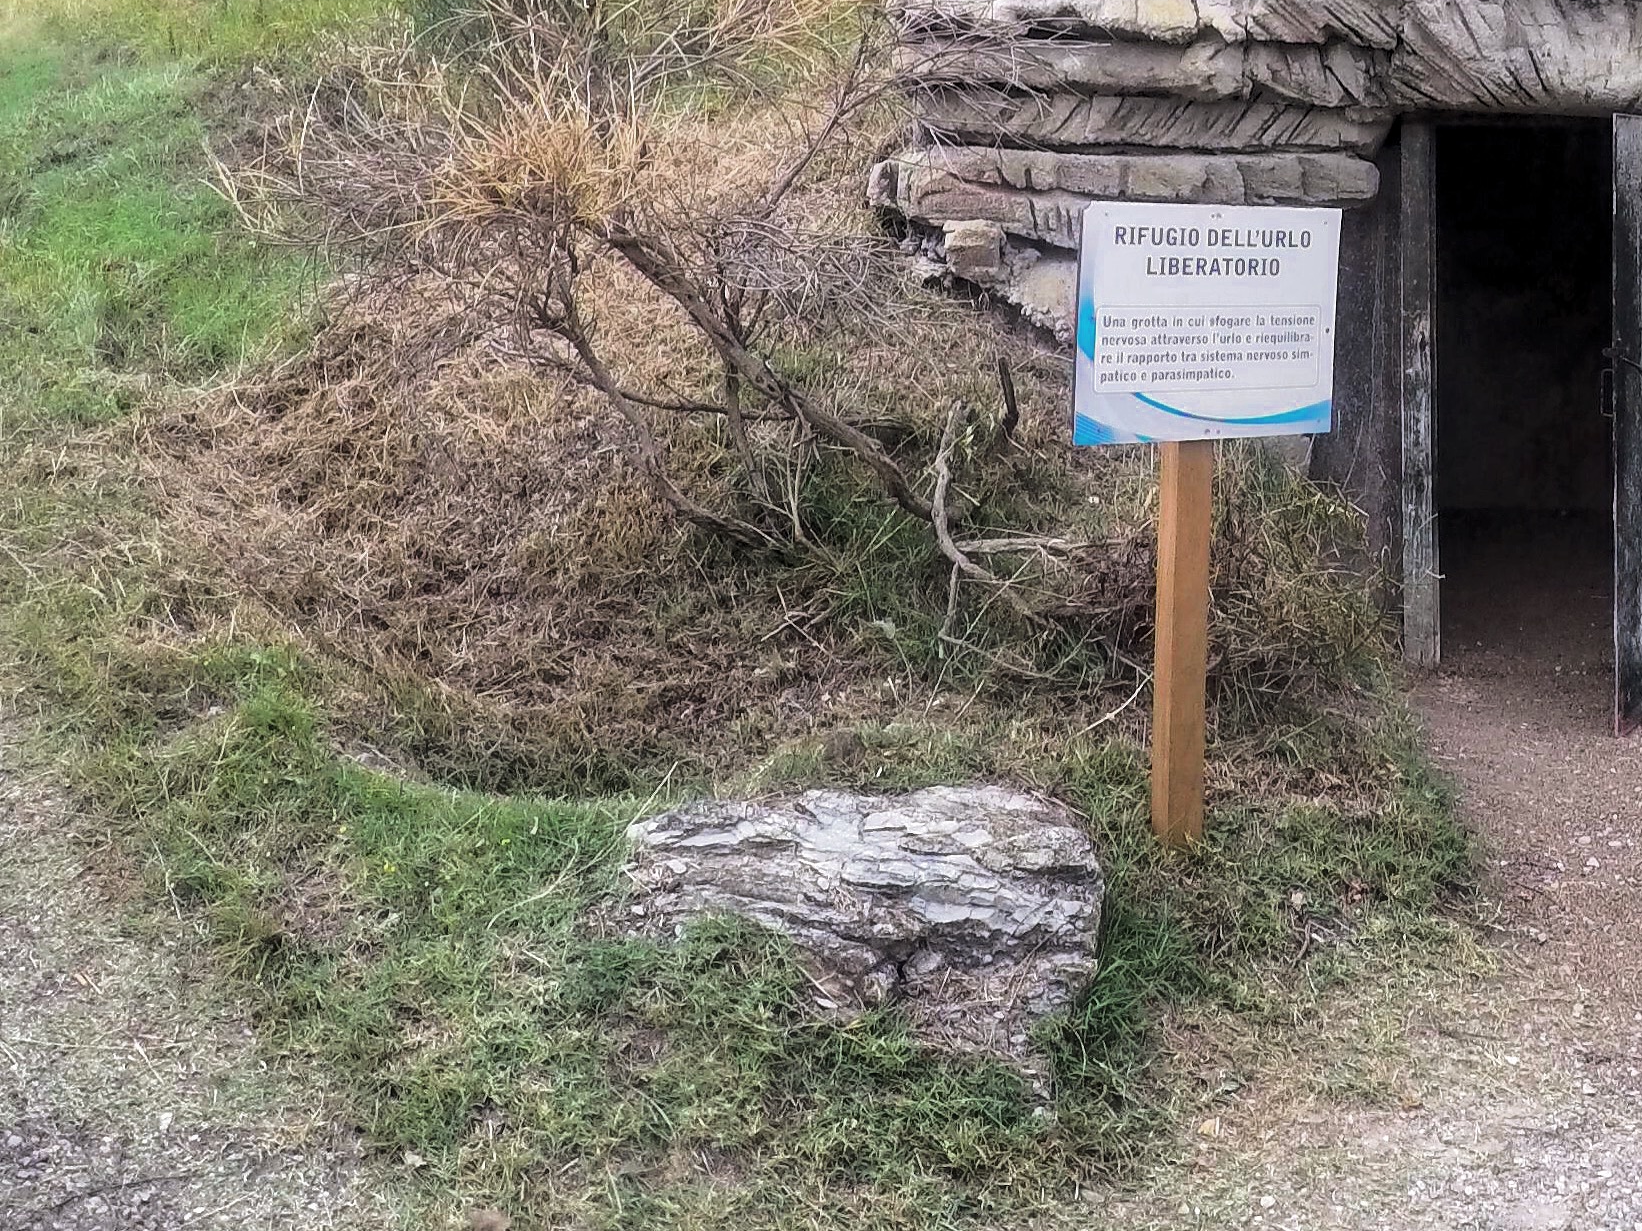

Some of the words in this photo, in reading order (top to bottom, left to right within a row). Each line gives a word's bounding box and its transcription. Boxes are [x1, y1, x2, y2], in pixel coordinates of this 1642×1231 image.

[1115, 226, 1199, 246] RIFUGIO
[1146, 257, 1280, 276] LIBERATORIO
[1103, 316, 1126, 328] Una
[1132, 316, 1167, 329] grotta
[1172, 316, 1183, 327] in
[1188, 316, 1205, 327] cui
[1209, 315, 1251, 329] sfogare
[1256, 315, 1265, 325] la
[1270, 315, 1314, 325] tensione
[1102, 334, 1146, 345] nervosa
[1151, 333, 1208, 344] attraverso
[1246, 335, 1251, 343] e
[1101, 353, 1112, 364] re
[1116, 351, 1124, 364] il
[1128, 351, 1177, 365] rapporto
[1181, 351, 1197, 363] tra
[1201, 350, 1242, 362] sistema
[1247, 350, 1288, 361] nervoso
[1292, 349, 1314, 360] sim-
[1100, 370, 1136, 384] patico
[1141, 372, 1147, 381] e
[1151, 370, 1235, 383] parasimpatico.
